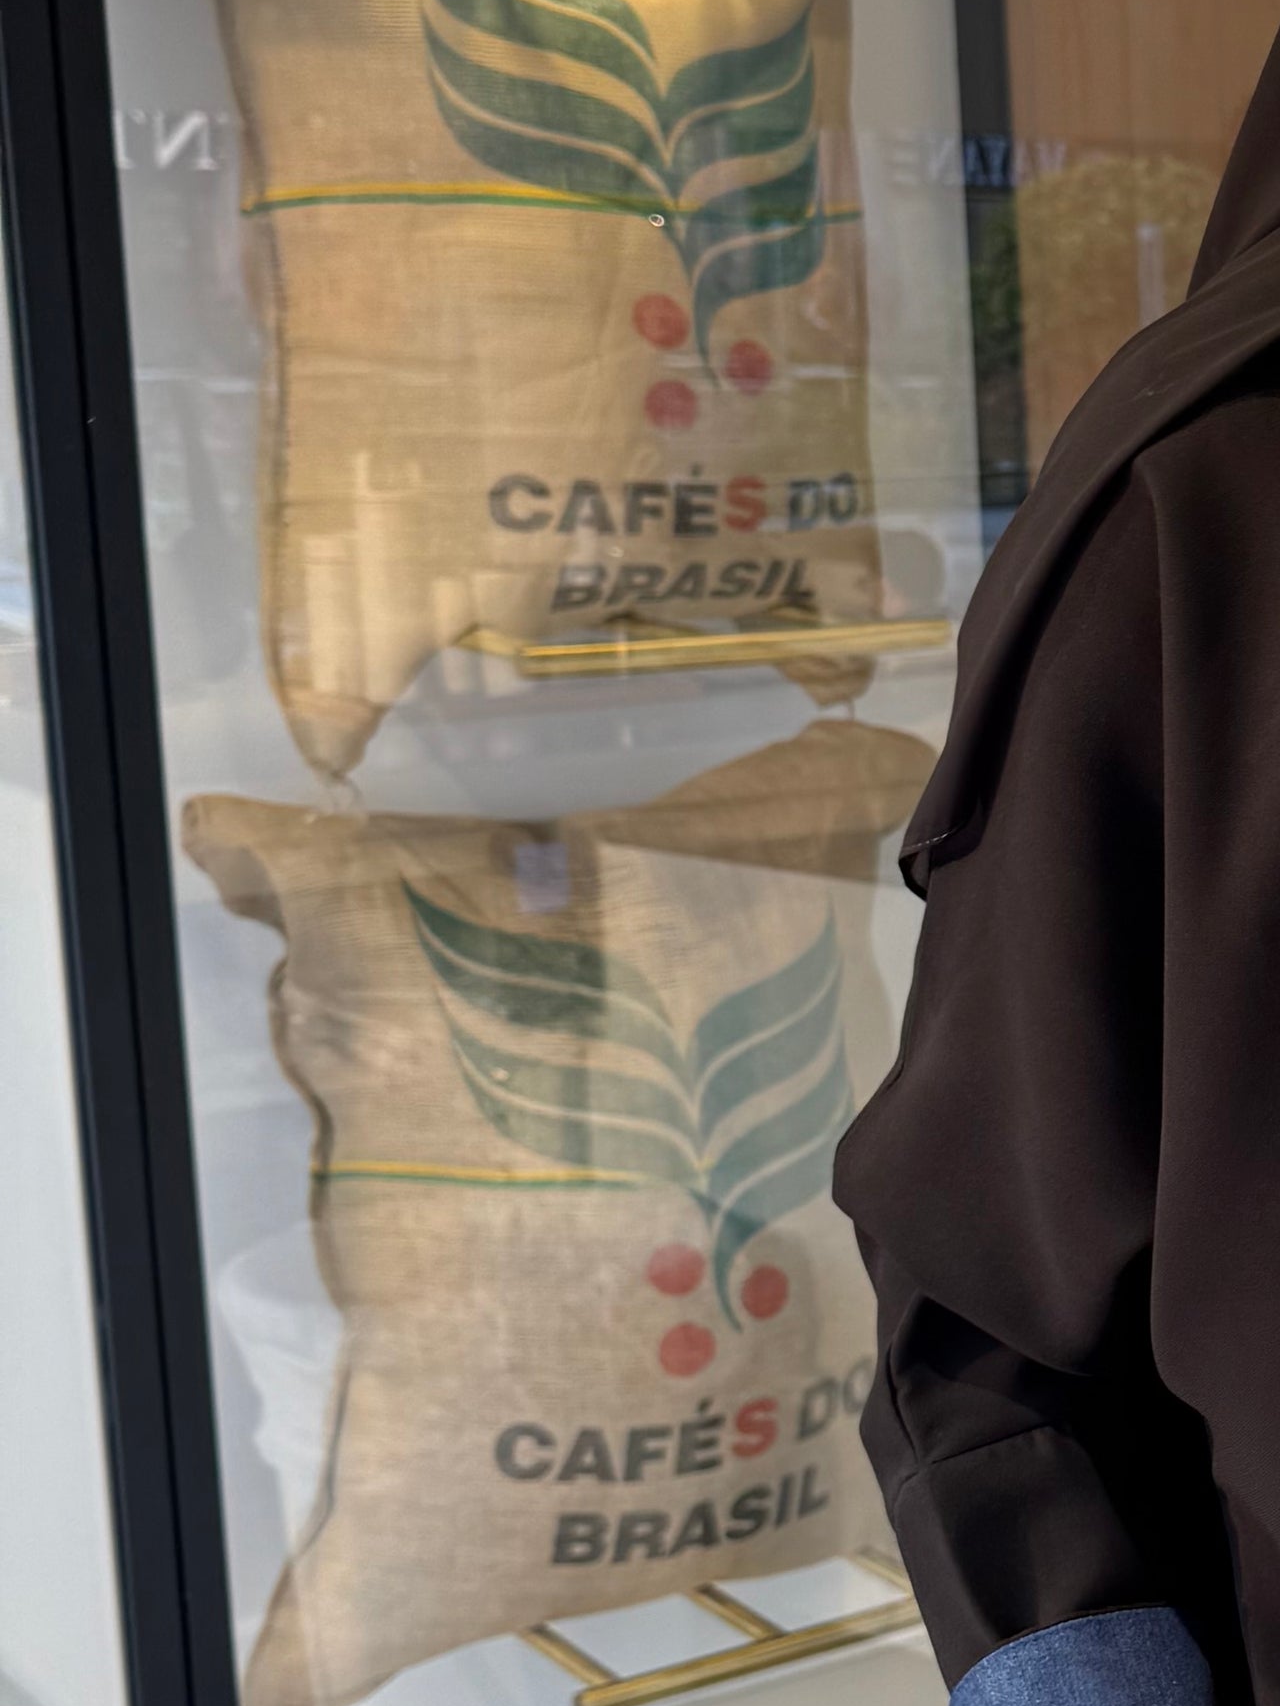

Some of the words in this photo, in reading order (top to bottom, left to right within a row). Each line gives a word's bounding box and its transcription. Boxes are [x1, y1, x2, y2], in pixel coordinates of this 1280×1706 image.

[488, 462, 768, 538] CAFÉS
[784, 471, 859, 533] DO
[550, 557, 816, 613] BRASIL
[494, 1397, 779, 1482] CAFÉS
[550, 1465, 831, 1565] BRASIL
